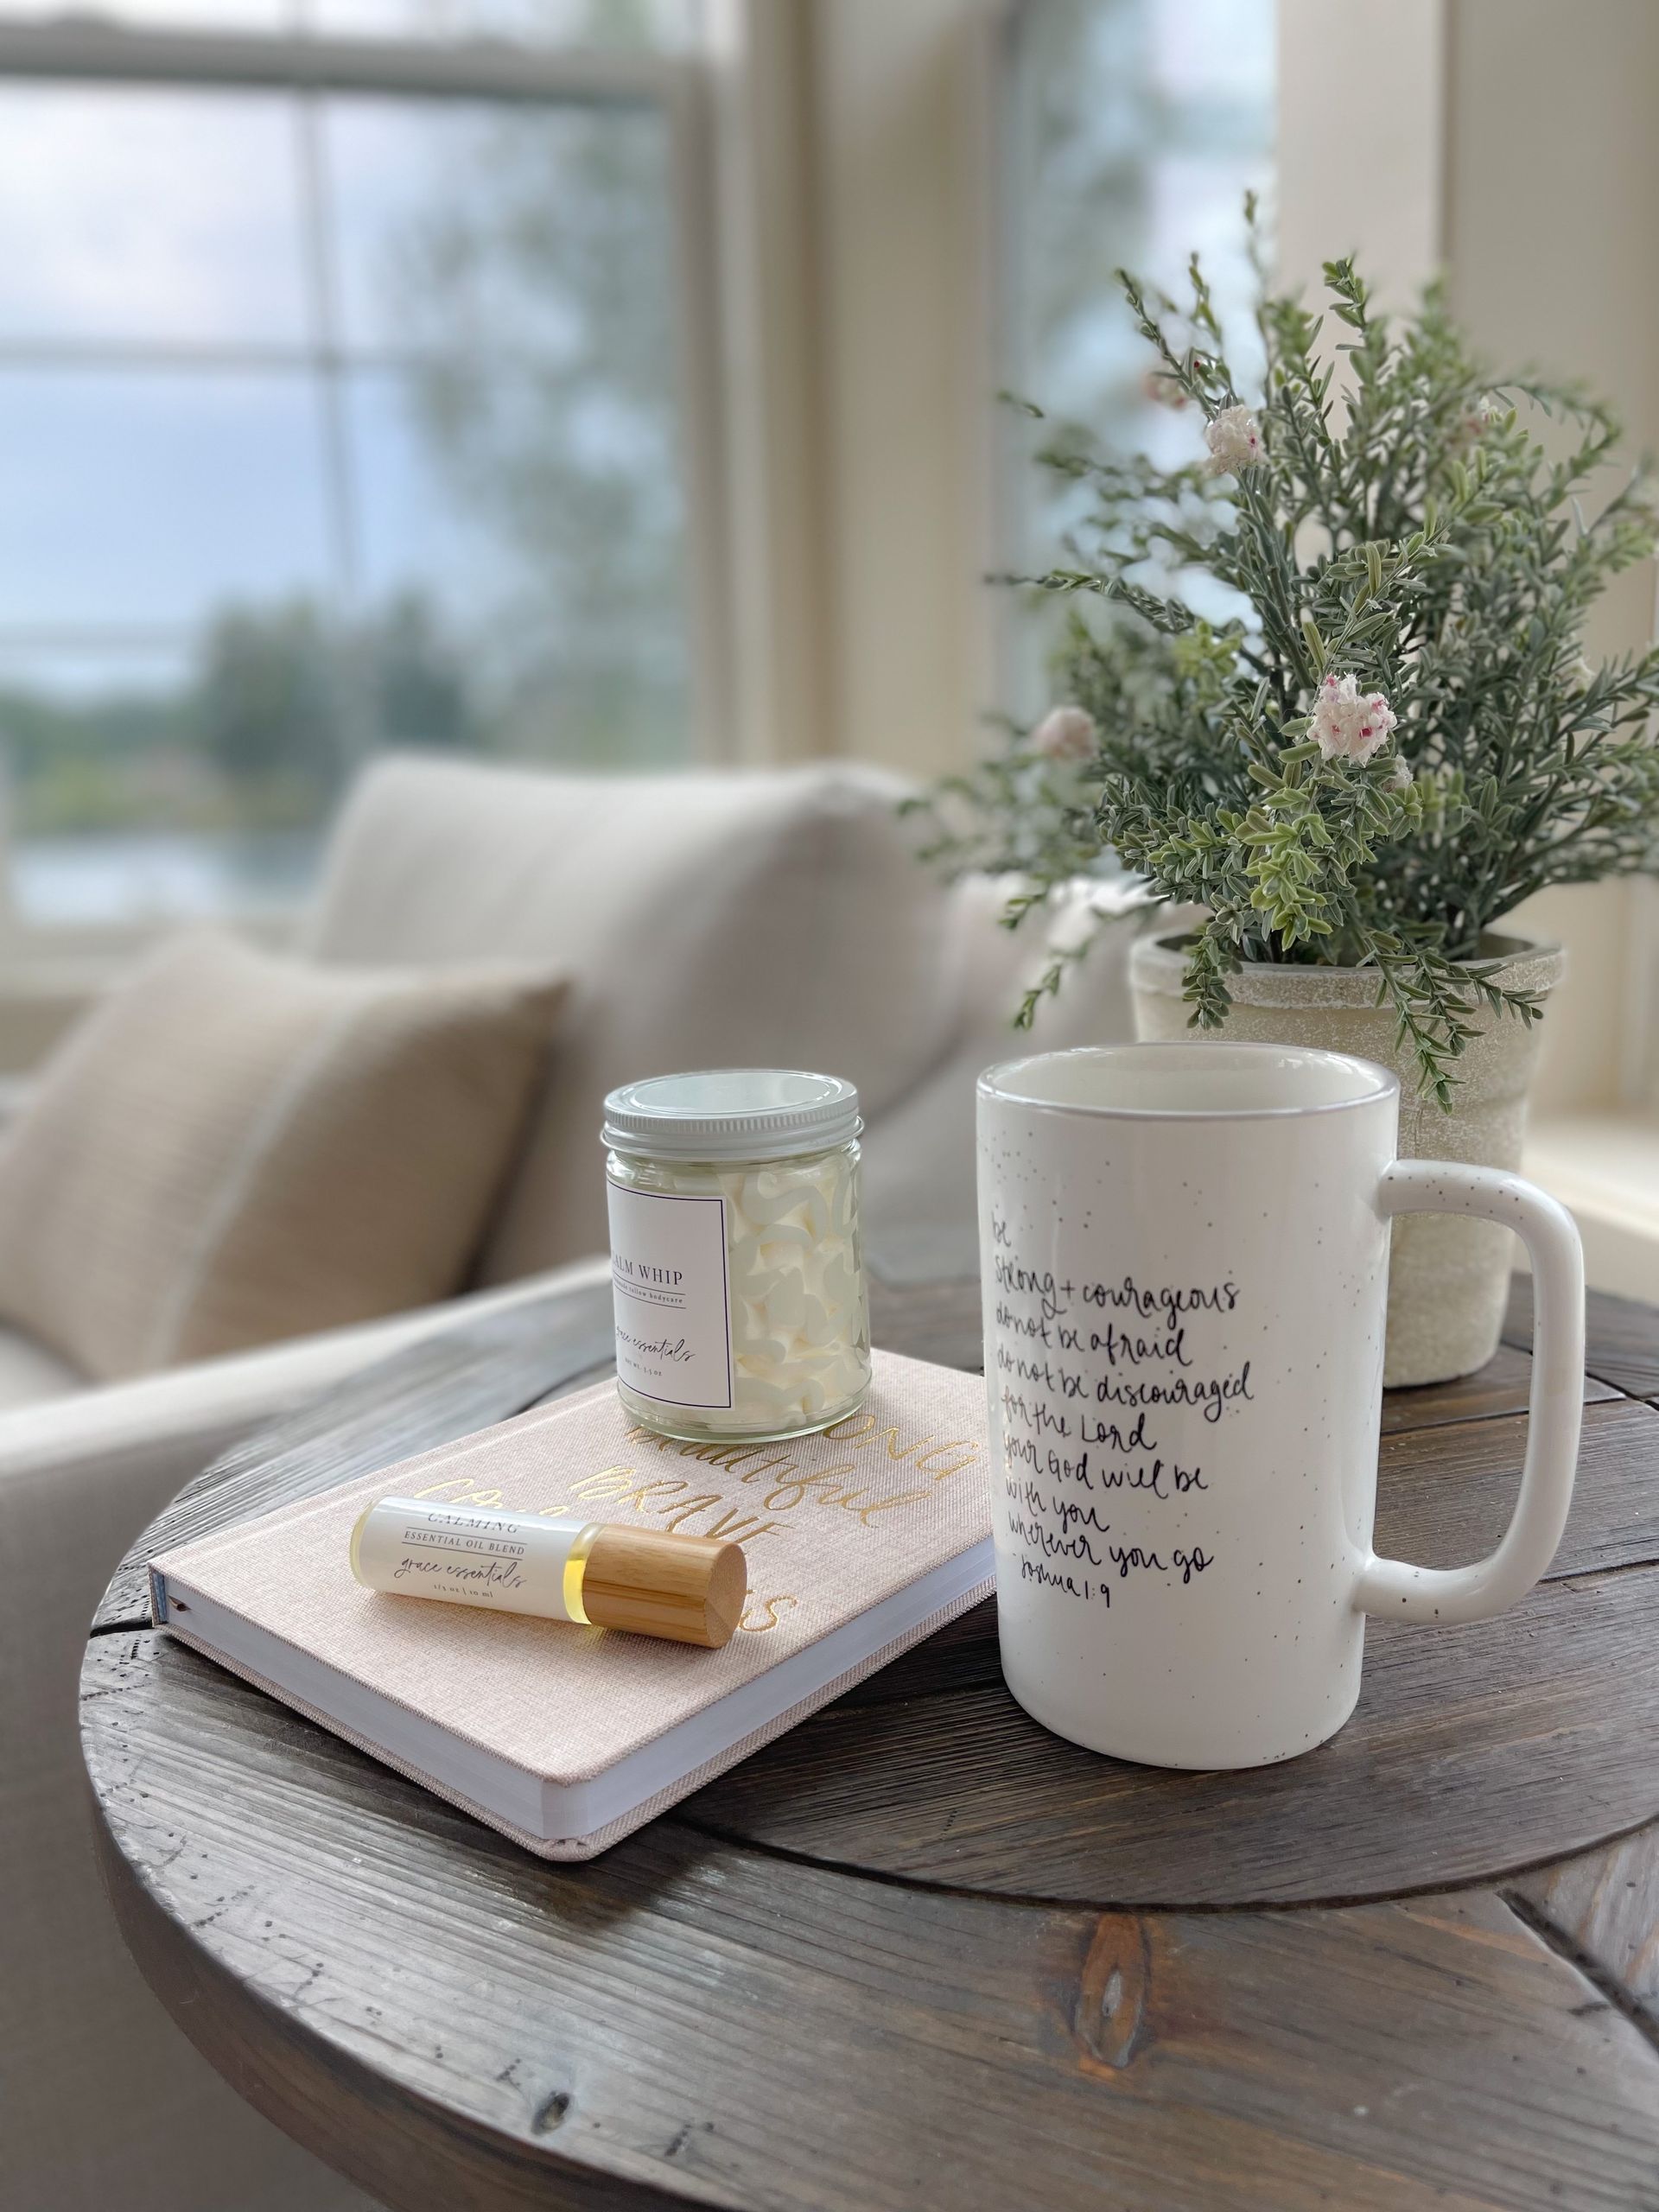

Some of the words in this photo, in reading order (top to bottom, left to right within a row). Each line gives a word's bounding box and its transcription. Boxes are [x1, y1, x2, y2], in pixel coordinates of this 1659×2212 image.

[992, 1211, 1011, 1247] be
[639, 1264, 683, 1286] WHIP
[650, 1293, 683, 1304] bodycare
[1060, 1280, 1076, 1300] +
[1083, 1276, 1240, 1330] courageous
[632, 1338, 696, 1363] essentials
[1058, 1325, 1085, 1352] be
[1090, 1323, 1193, 1366] afraid
[1060, 1367, 1090, 1398] be
[1096, 1361, 1254, 1422] discouraged
[1001, 1384, 1033, 1427] for
[1033, 1401, 1071, 1438] the
[1081, 1412, 1158, 1452] Lord
[1002, 1430, 1044, 1474] your
[1047, 1452, 1094, 1491] God
[1102, 1459, 1168, 1499] will
[1174, 1464, 1208, 1491] be
[428, 1513, 519, 1534] CALMING
[568, 1465, 794, 1547] BRAVE
[1006, 1477, 1046, 1516] with
[1052, 1495, 1109, 1534] you
[404, 1530, 461, 1547] ESSENTIAL
[466, 1539, 484, 1550] OIL
[488, 1542, 525, 1555] BLEND
[1008, 1511, 1102, 1566] wherever
[1109, 1545, 1167, 1577] you
[1173, 1547, 1214, 1584] go
[394, 1558, 442, 1578] grace
[446, 1561, 527, 1588] essentials
